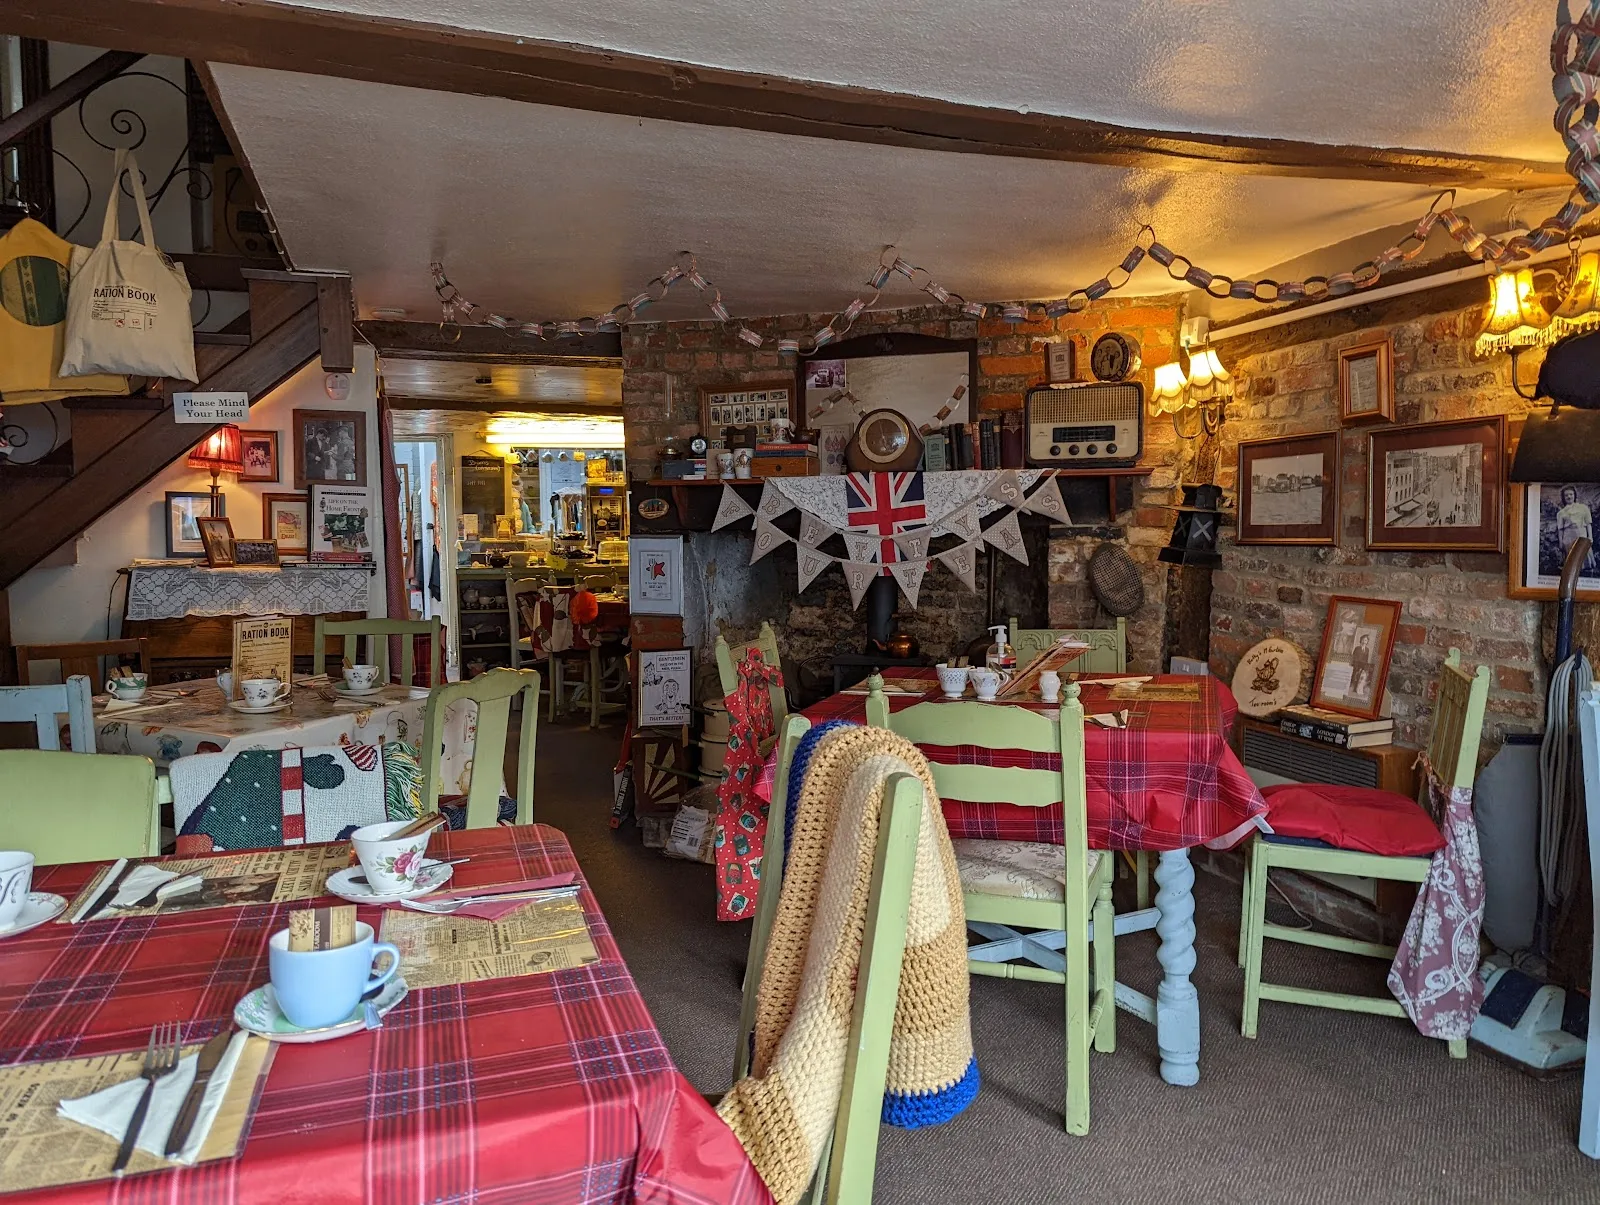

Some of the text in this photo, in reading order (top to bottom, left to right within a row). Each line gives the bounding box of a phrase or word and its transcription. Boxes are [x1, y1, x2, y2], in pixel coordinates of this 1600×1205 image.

[93, 288, 157, 303] RATION BOOK
[183, 399, 246, 407] Please Mind
[186, 409, 243, 418] Your Head
[242, 626, 290, 640] RATION BOOK
[1316, 728, 1337, 738] LONDON
